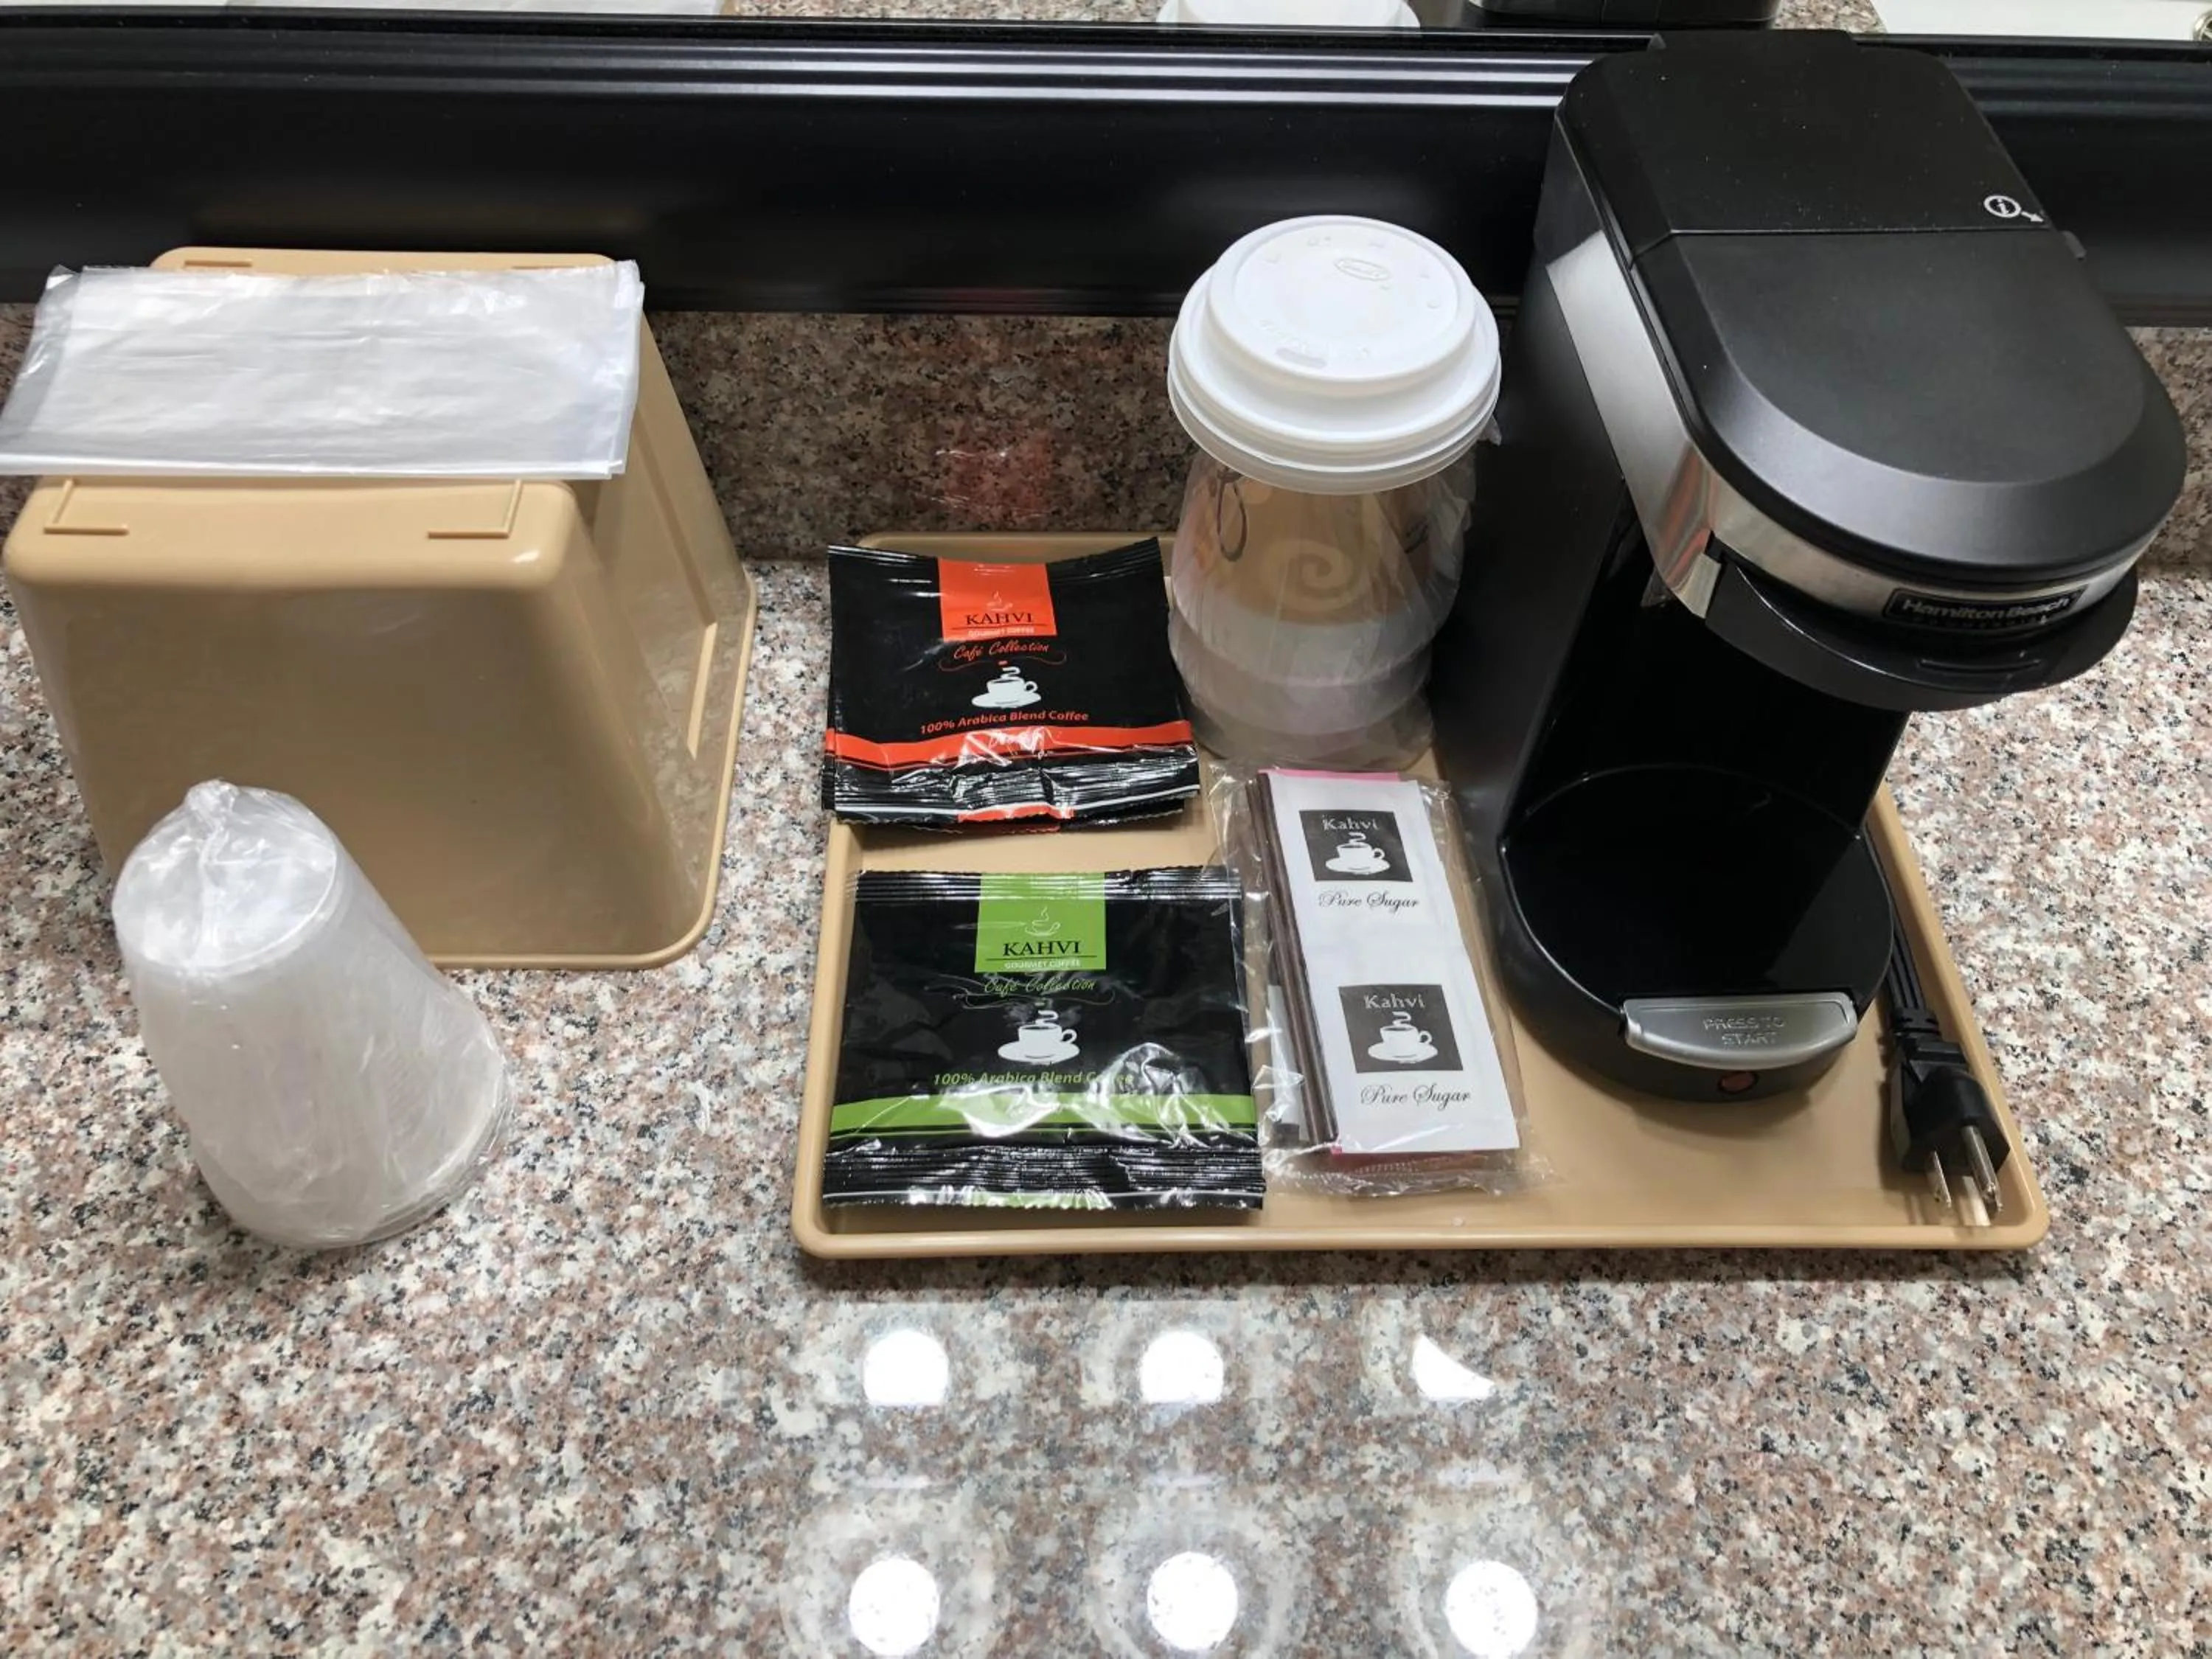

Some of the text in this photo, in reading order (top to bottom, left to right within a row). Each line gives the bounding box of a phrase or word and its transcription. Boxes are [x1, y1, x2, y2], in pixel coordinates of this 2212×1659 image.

[966, 613, 1033, 626] KAHVI
[989, 639, 1049, 655] Collection
[920, 710, 1090, 734] 100% Arabica Blend Coffee
[1322, 815, 1380, 831] Kahvi
[1318, 888, 1419, 914] Pure Sugar
[1003, 940, 1082, 956] KAHVI
[1364, 992, 1426, 1009] Kahvi
[933, 1074, 975, 1086] 100%
[978, 1072, 1035, 1085] Arabica
[1040, 1071, 1083, 1084] Blend
[1360, 1082, 1472, 1111] Pure Sugar
